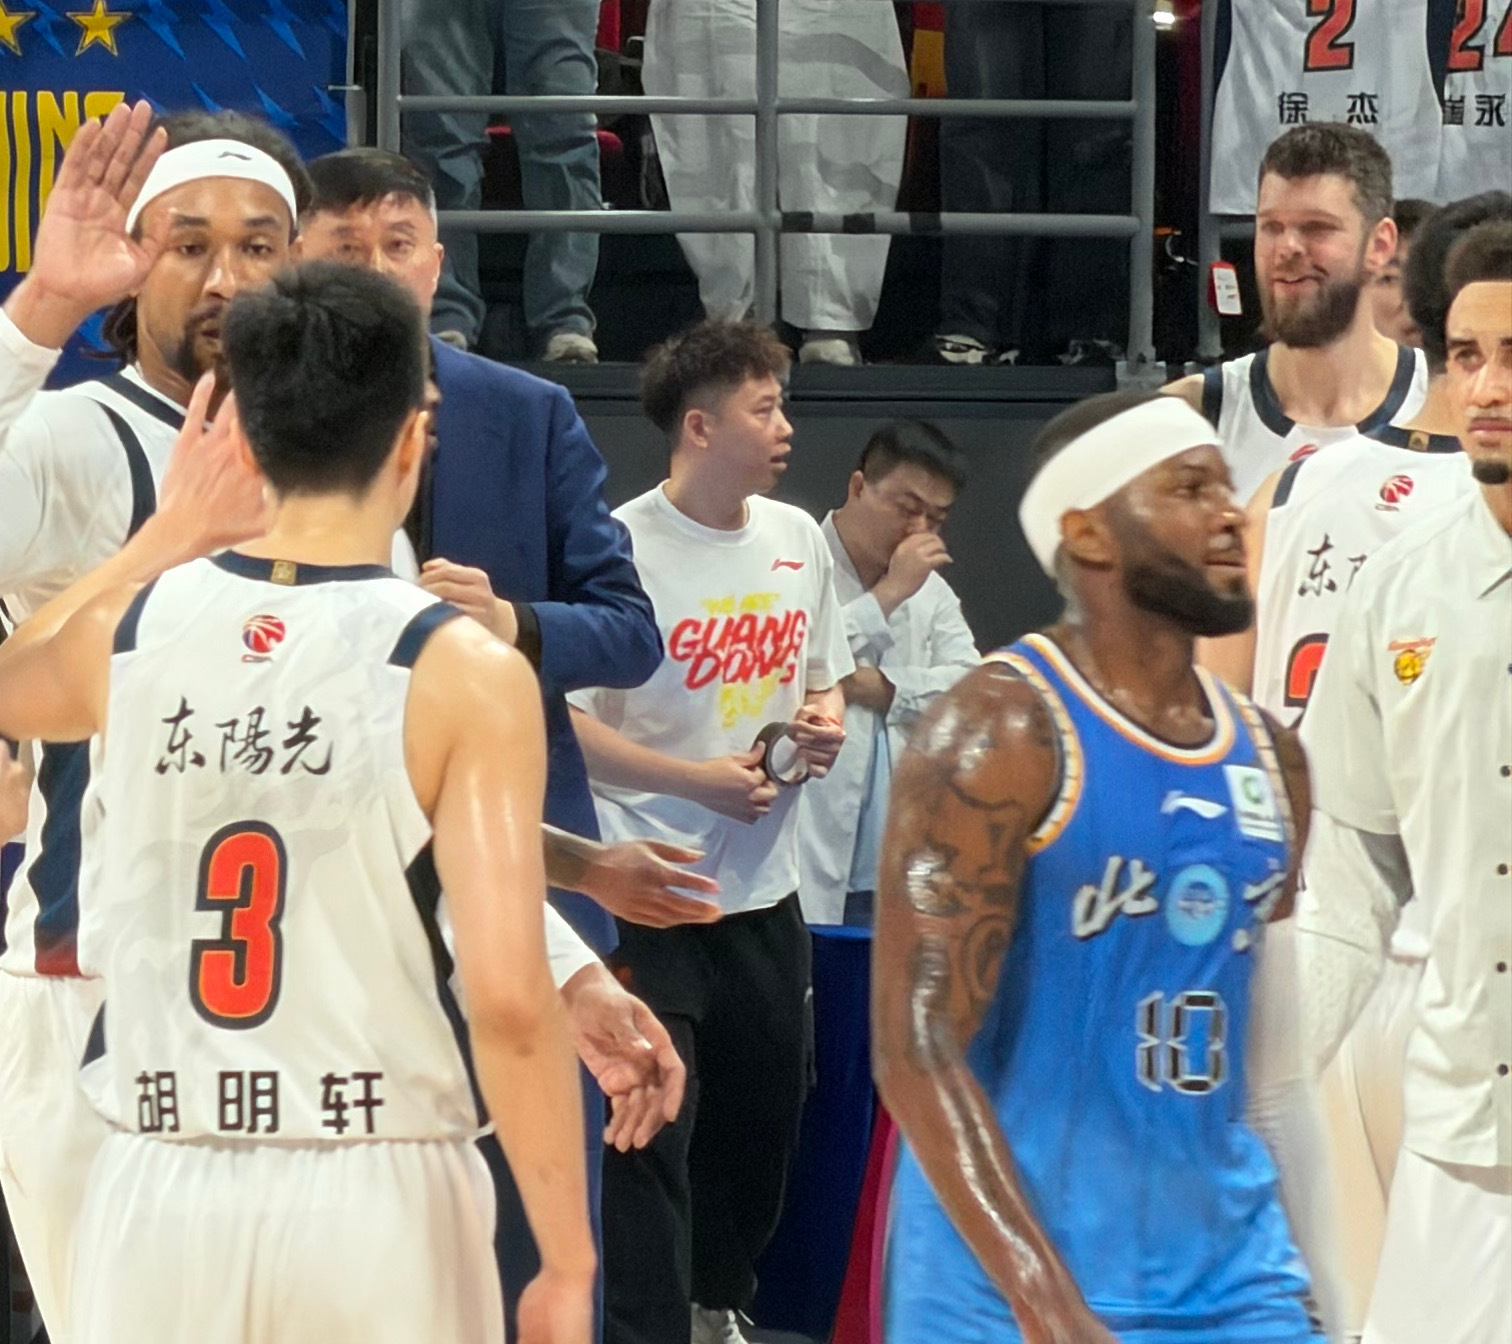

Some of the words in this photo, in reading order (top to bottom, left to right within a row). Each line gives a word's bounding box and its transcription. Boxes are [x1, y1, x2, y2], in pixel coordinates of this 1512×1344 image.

[1278, 91, 1379, 124] 徐杰
[669, 610, 807, 663] GUANG
[188, 819, 288, 1031] 3
[1135, 989, 1229, 1096] 10
[135, 1070, 386, 1135] 胡明轩
